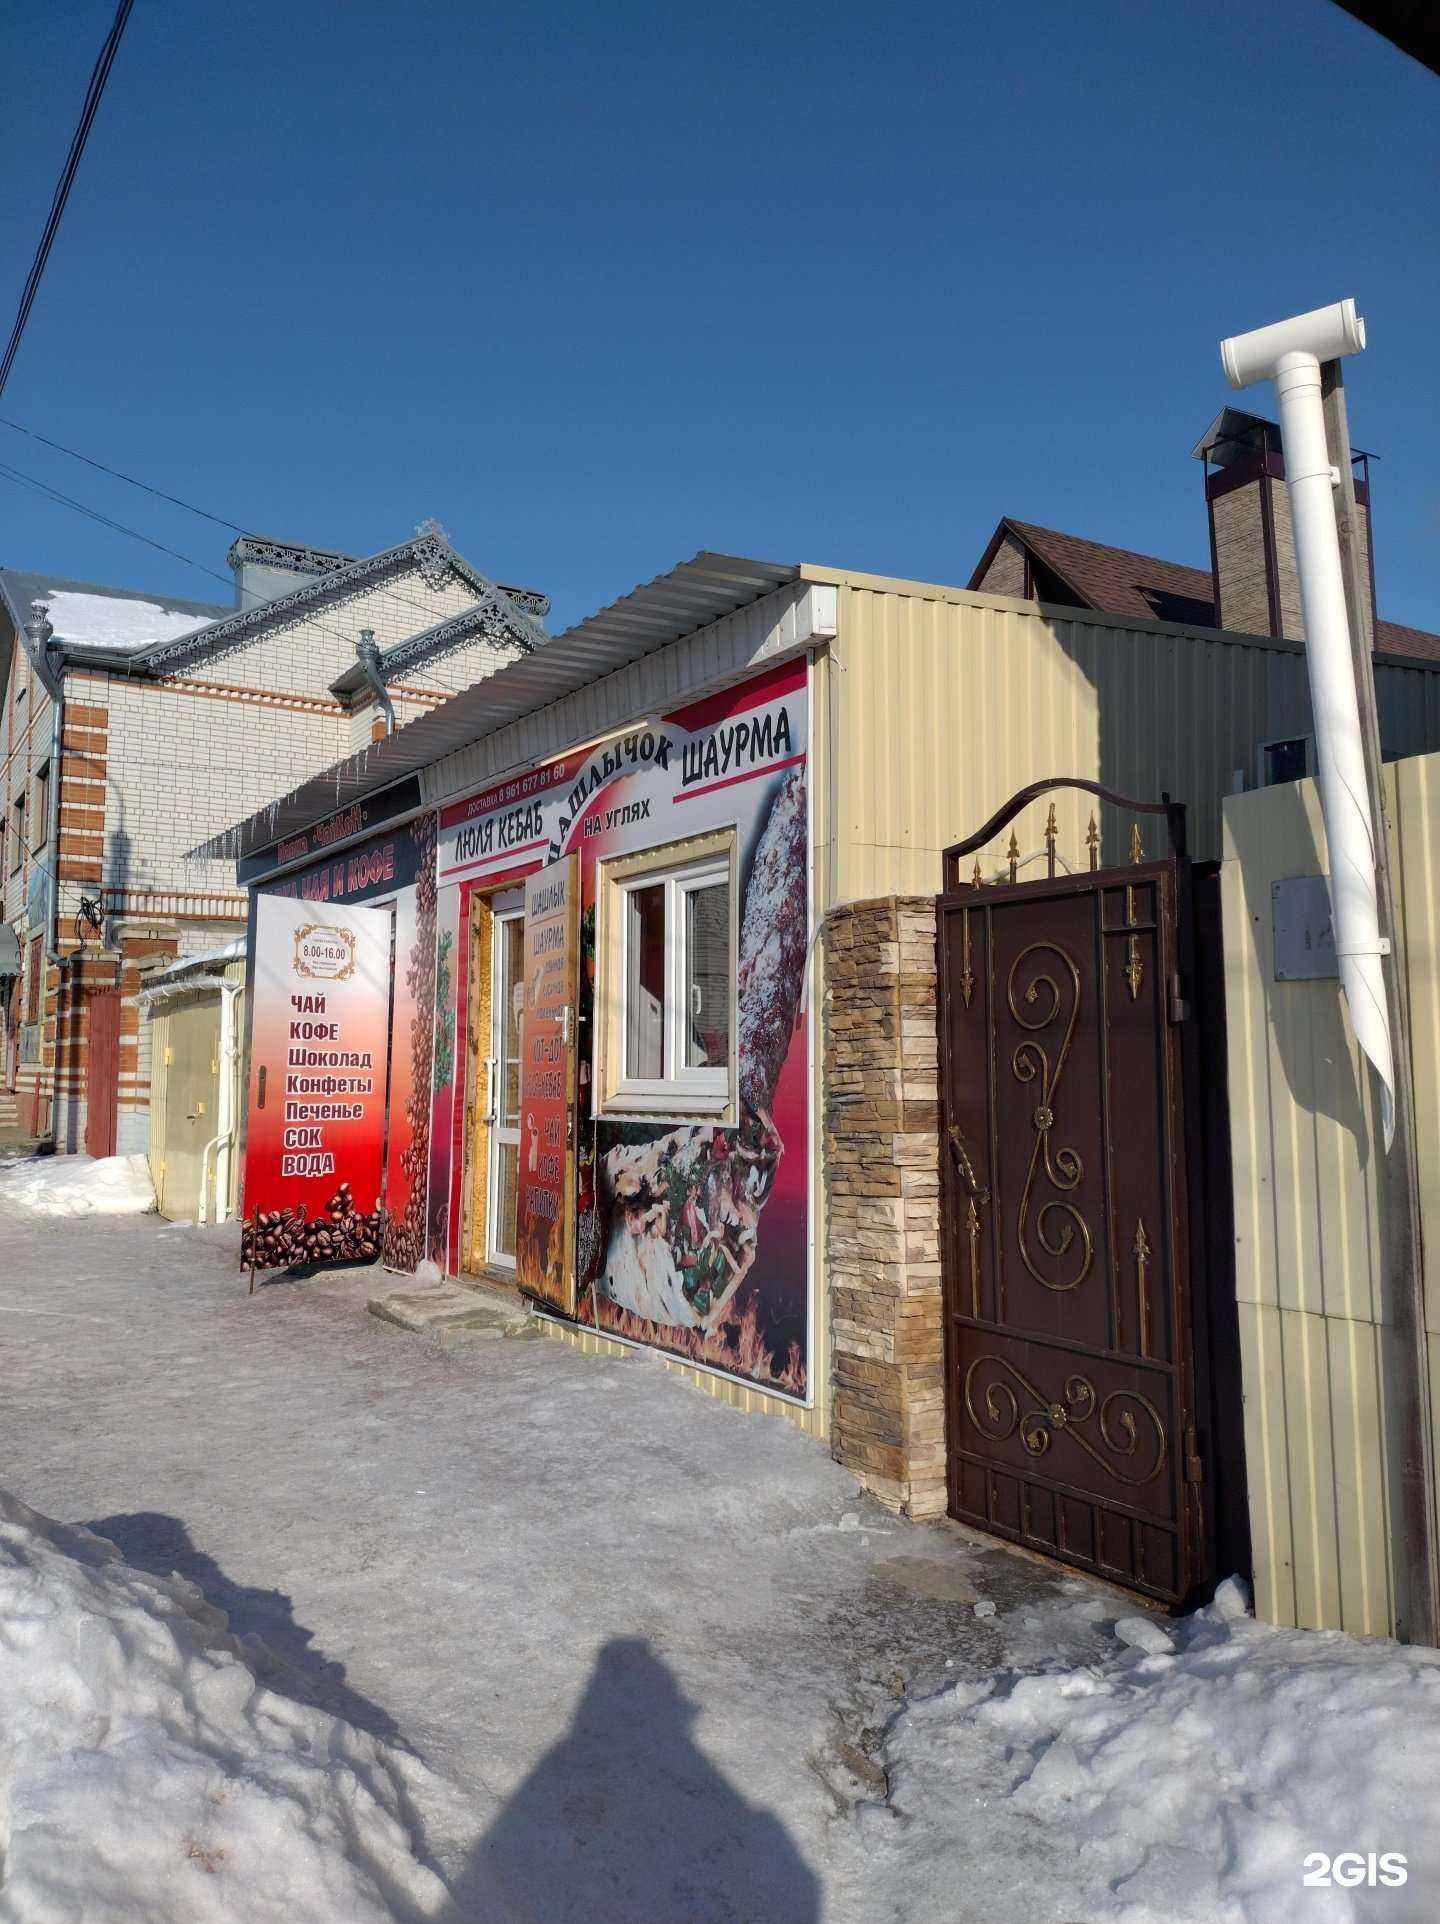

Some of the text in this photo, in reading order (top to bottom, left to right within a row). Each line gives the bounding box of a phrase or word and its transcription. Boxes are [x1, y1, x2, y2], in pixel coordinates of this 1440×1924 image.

[681, 707, 792, 787] ШАУРМА
[505, 785, 521, 802] 961
[523, 773, 539, 793] 677
[540, 770, 551, 786] 81
[553, 763, 565, 780] 60
[455, 801, 543, 862] ЛЮЛЯ КЕБАБ
[583, 798, 652, 839] НА УГЛЯХ
[347, 843, 394, 894] КОФЕ
[531, 880, 565, 917] ШАШЛЫК
[303, 944, 346, 960] 8.00-16.00
[533, 922, 565, 957] ШАУРМА
[291, 992, 326, 1014] ЧАЙ
[289, 1021, 339, 1041] КОФЕ
[288, 1048, 372, 1069] Шоколад
[286, 1075, 373, 1096] Конфеты
[285, 1102, 364, 1122] Печенье
[284, 1127, 322, 1149] СОК
[544, 1115, 561, 1148] ЧАЙ
[282, 1153, 334, 1178] ВОДА
